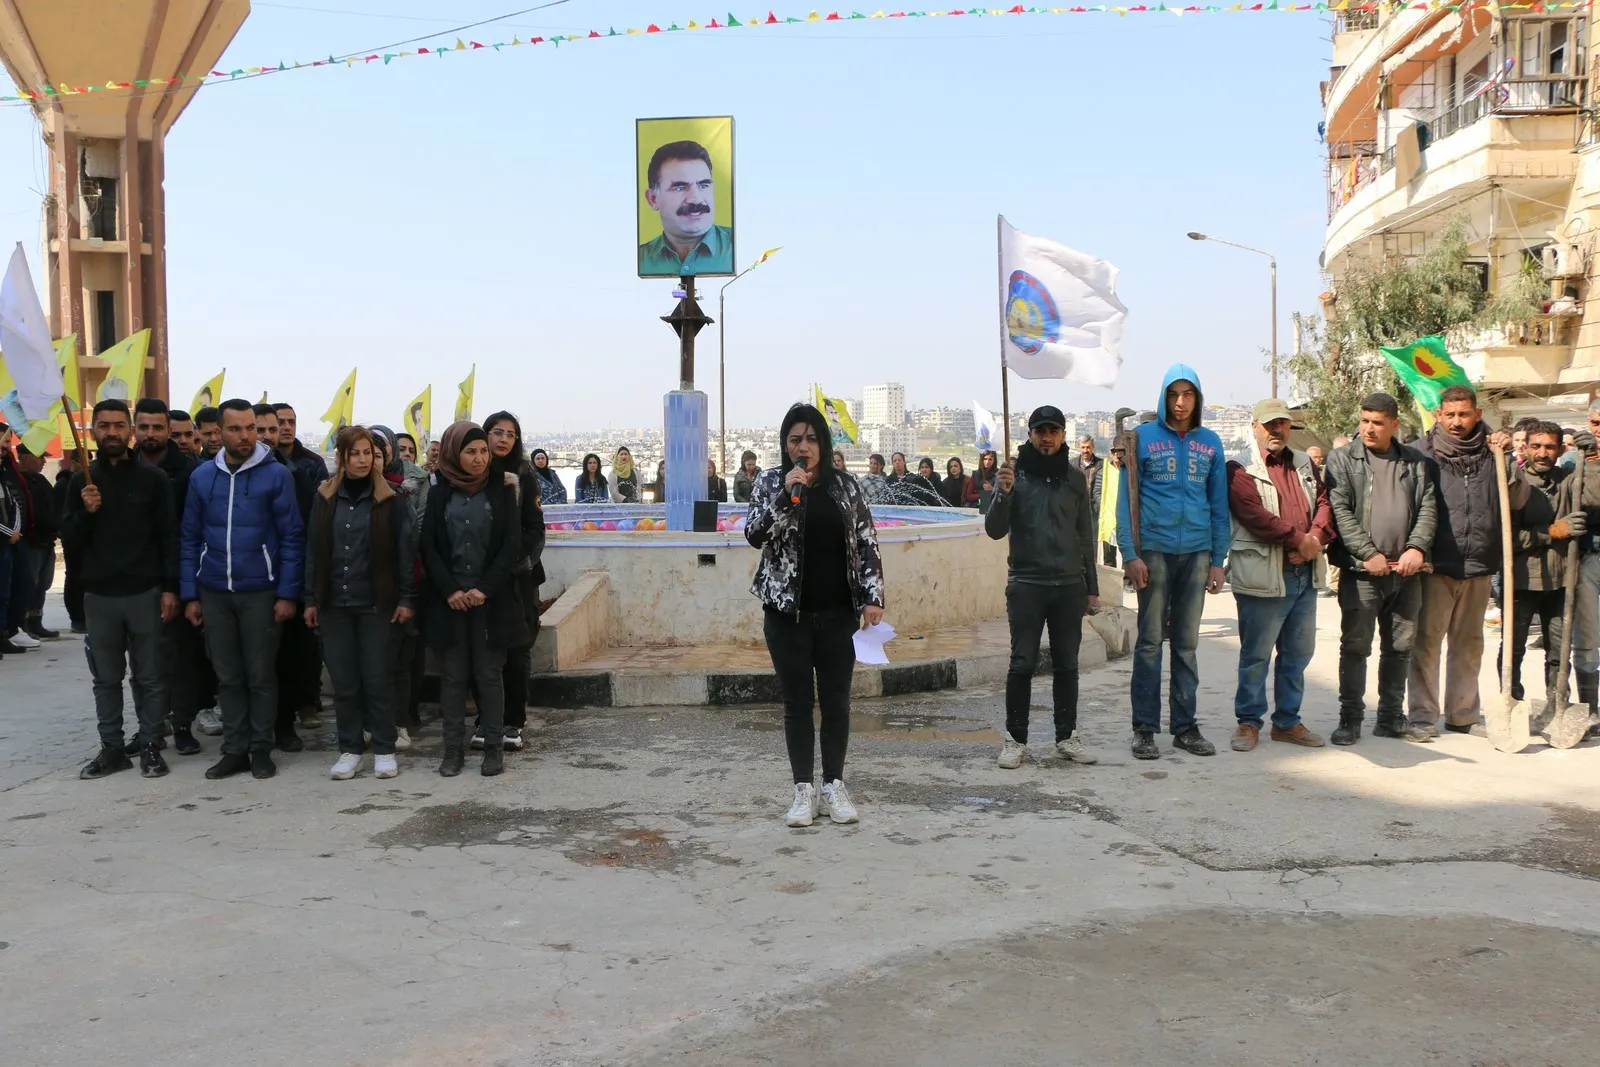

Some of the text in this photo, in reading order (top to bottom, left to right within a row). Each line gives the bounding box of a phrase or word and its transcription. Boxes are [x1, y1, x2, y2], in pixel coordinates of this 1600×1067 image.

[1147, 440, 1215, 457] HILL SIDE
[1167, 457, 1177, 472] 8
[1188, 458, 1198, 474] 5
[1152, 473, 1177, 481] COYOTE
